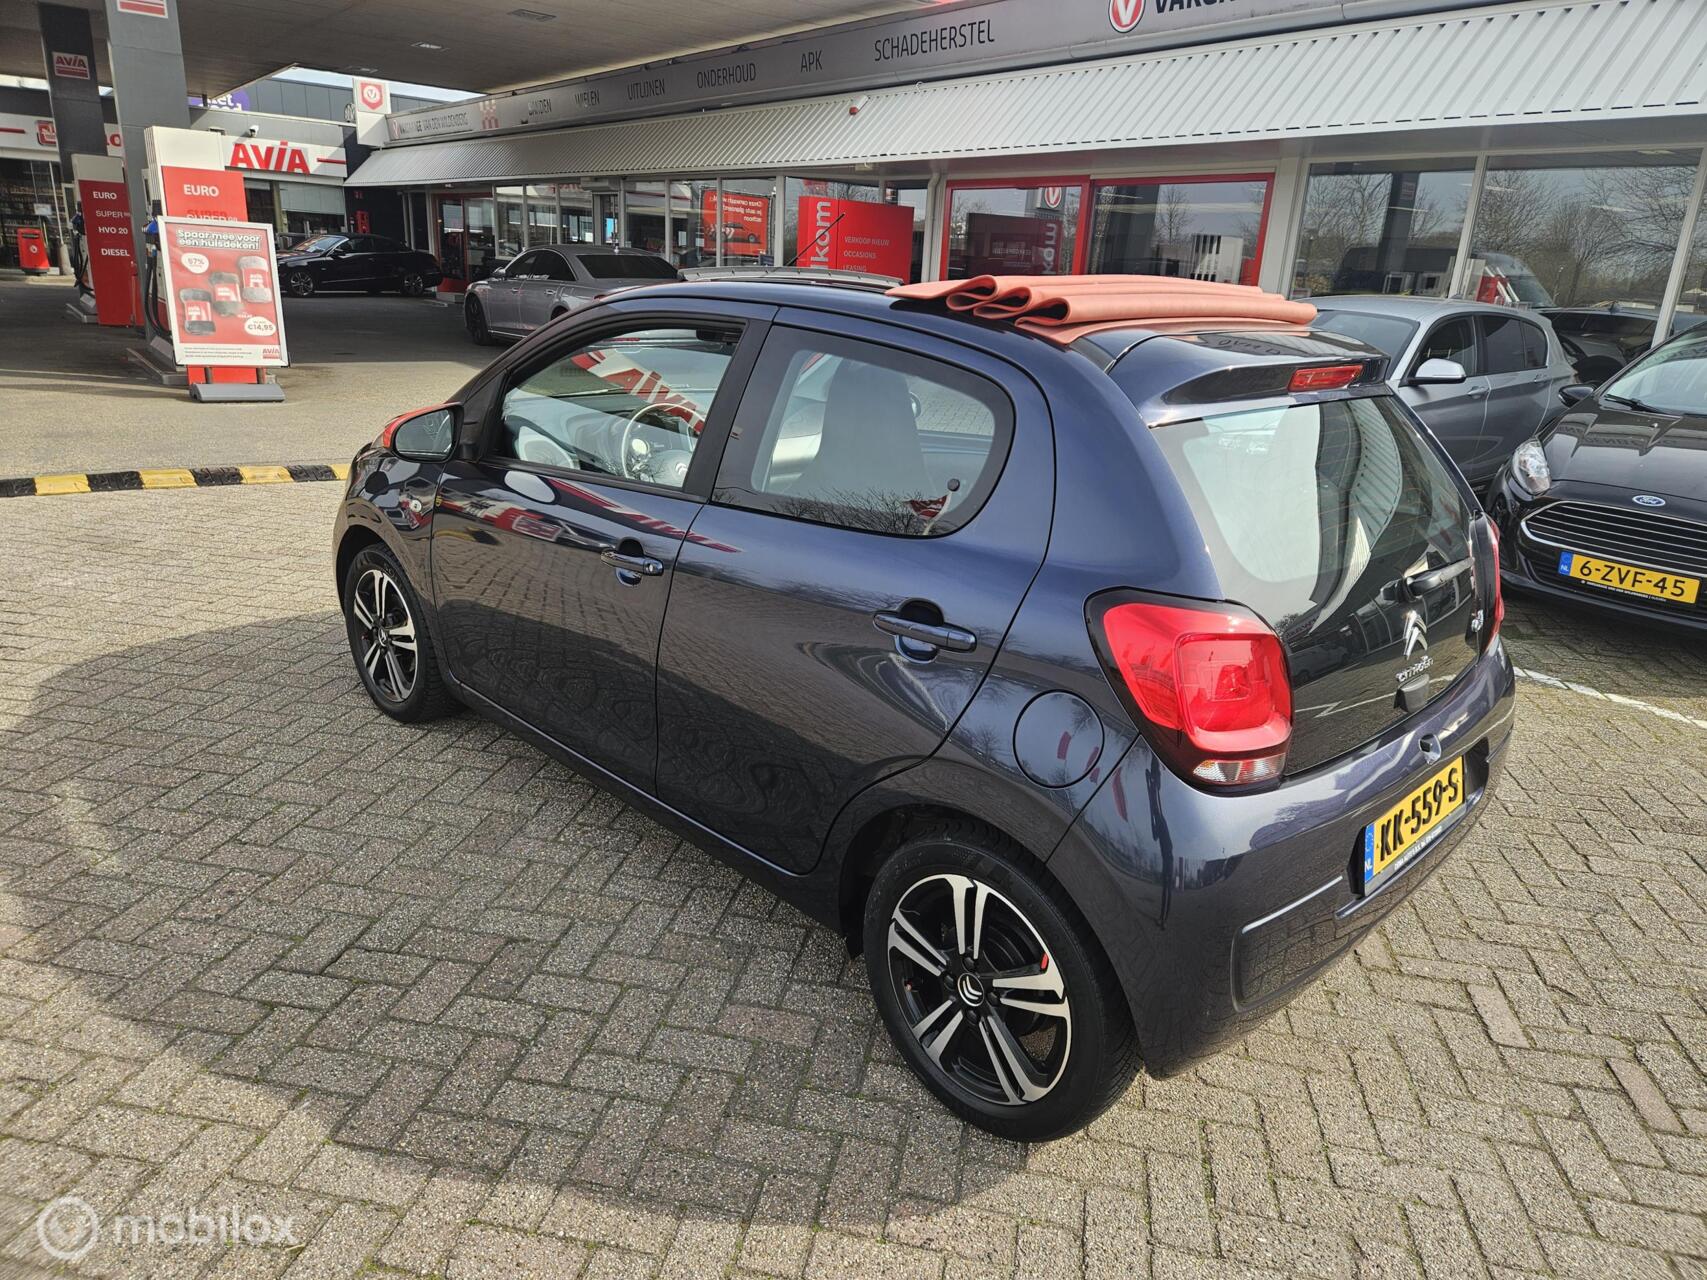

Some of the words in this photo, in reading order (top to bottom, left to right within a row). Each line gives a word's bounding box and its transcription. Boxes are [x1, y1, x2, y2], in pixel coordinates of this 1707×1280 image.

[874, 19, 995, 62] SCHADEHERSTEL
[55, 55, 87, 68] AVIA
[800, 50, 823, 72] APK
[696, 62, 757, 89] ONDERHOUD
[230, 140, 310, 176] AVIA
[93, 191, 117, 200] EURO
[184, 184, 220, 197] EURO
[96, 210, 124, 218] SUPER
[98, 226, 117, 234] HVO
[118, 227, 129, 235] 20
[178, 230, 208, 240] Spaar
[236, 234, 260, 242] voor
[101, 248, 130, 257] DIESEL
[843, 250, 876, 259] OCCASIONS
[1579, 560, 1686, 598] 6-ZVF-45
[1380, 767, 1459, 862] KK-559-S
